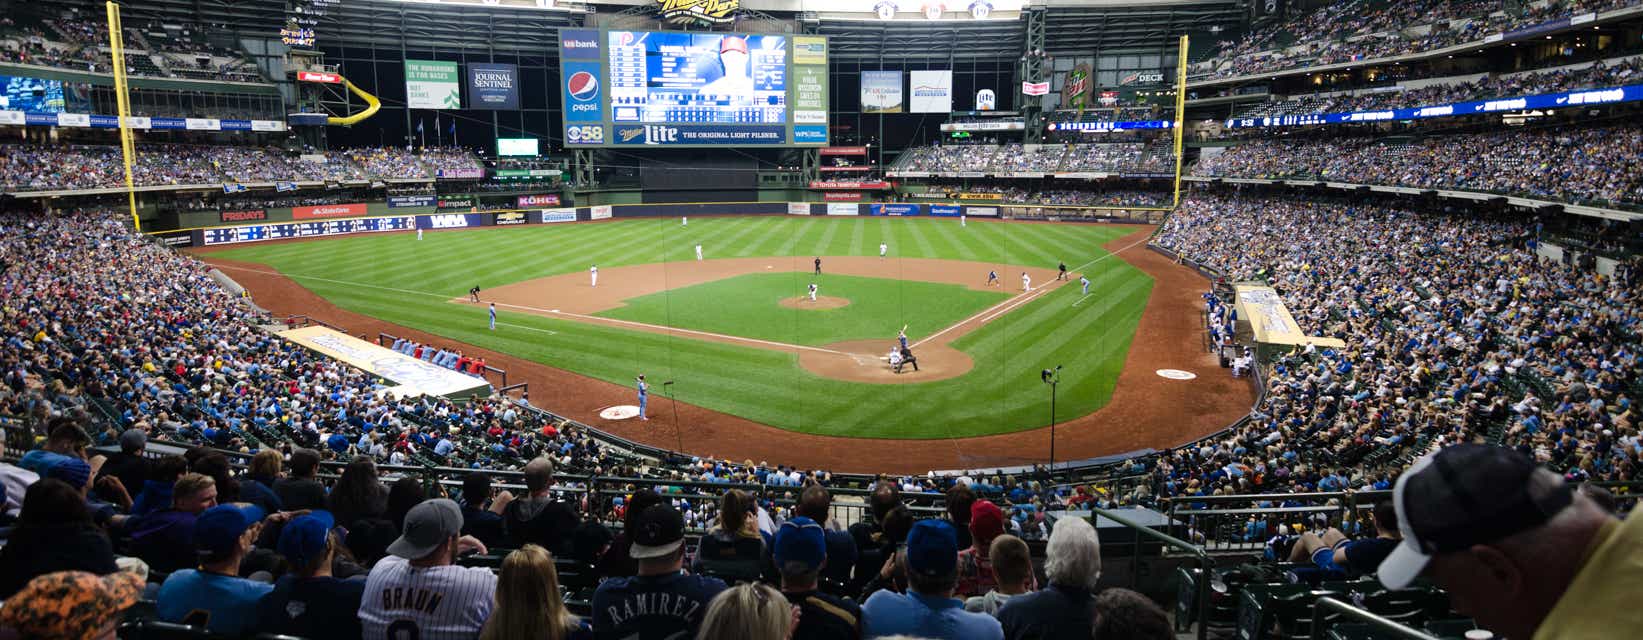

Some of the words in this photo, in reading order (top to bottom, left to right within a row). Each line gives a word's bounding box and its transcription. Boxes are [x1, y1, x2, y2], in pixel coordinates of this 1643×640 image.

[475, 72, 513, 81] JOURNAL
[1139, 74, 1164, 82] DECK
[979, 93, 992, 103] Lite
[572, 103, 597, 112] pepsi
[581, 126, 603, 140] 58
[644, 124, 678, 144] Lite
[444, 200, 471, 208] impact
[222, 211, 265, 221] FRIDAYS
[383, 587, 443, 615] BRAUN
[608, 592, 700, 626] RAMIREZ
